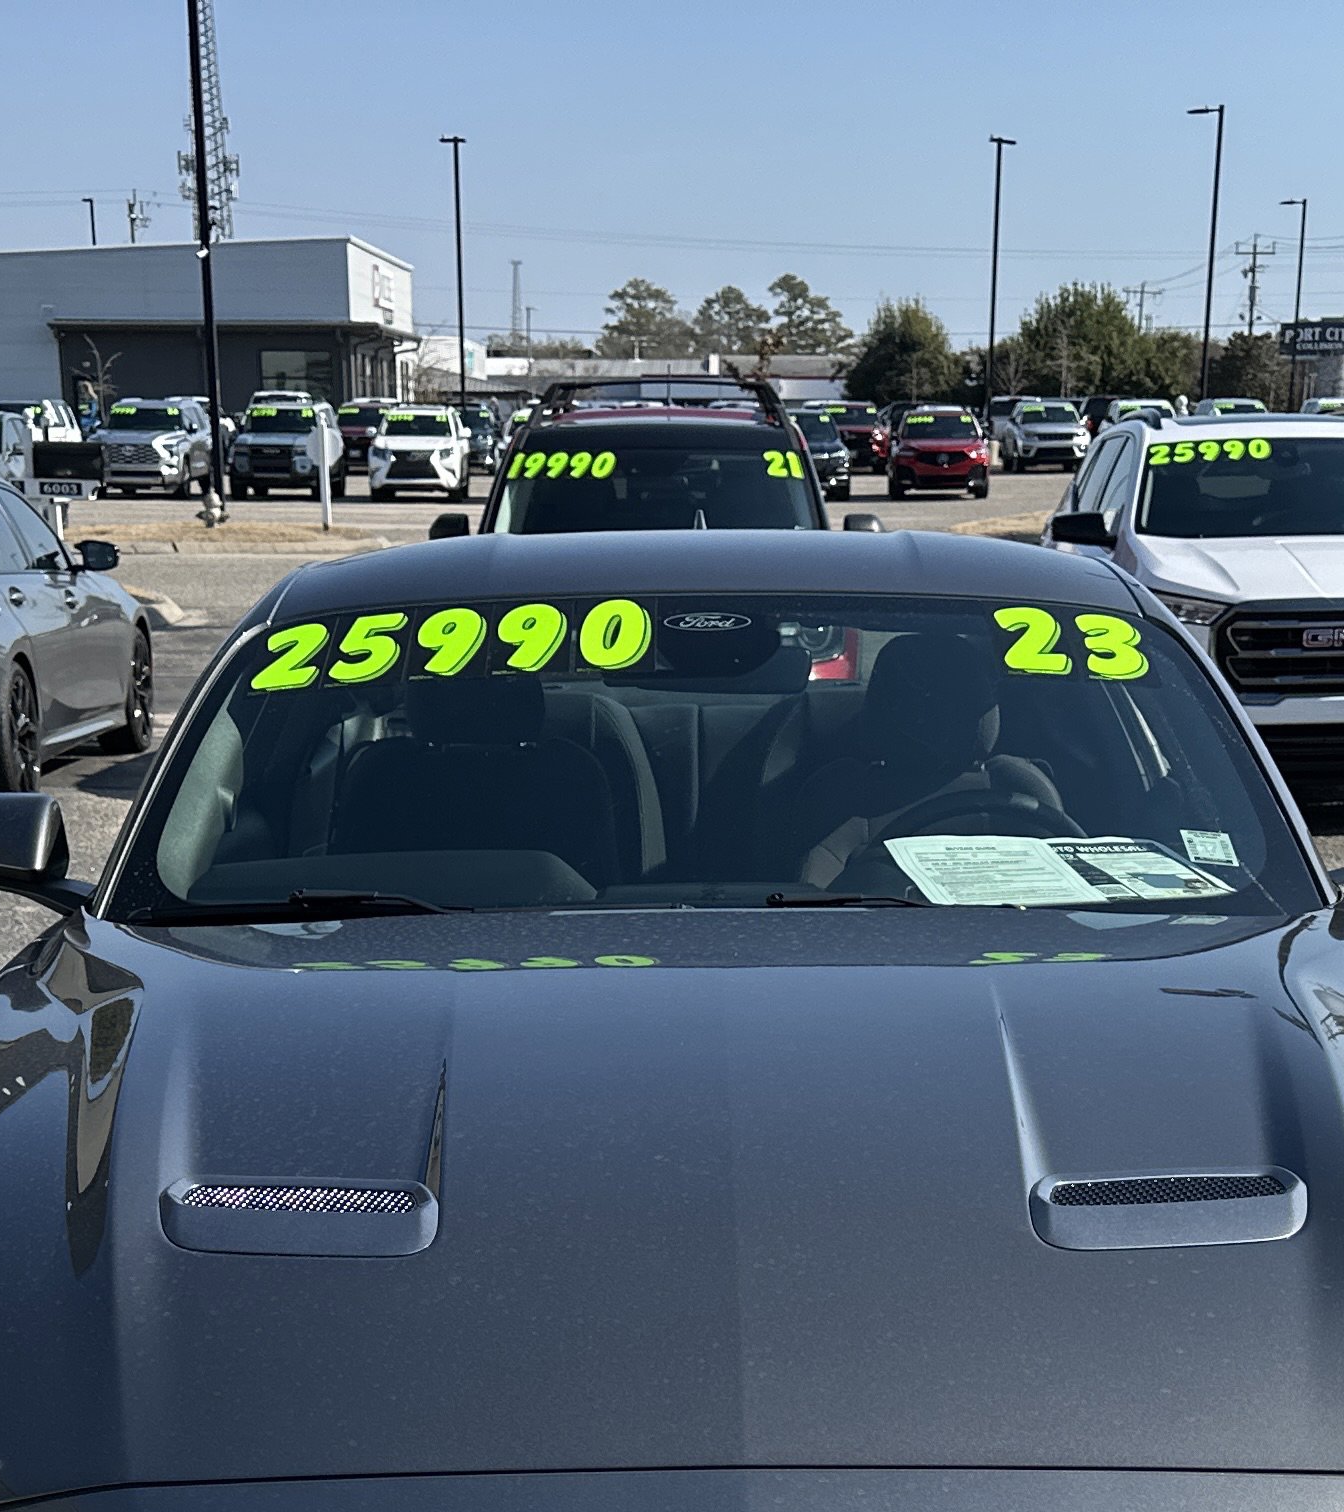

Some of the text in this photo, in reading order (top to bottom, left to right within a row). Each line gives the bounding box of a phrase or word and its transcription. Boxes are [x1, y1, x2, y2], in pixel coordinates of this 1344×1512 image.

[506, 450, 805, 480] 19990 21
[1148, 436, 1273, 467] 25990
[43, 483, 78, 495] 6003
[679, 615, 736, 628] Ford
[250, 599, 1150, 692] 25990 23
